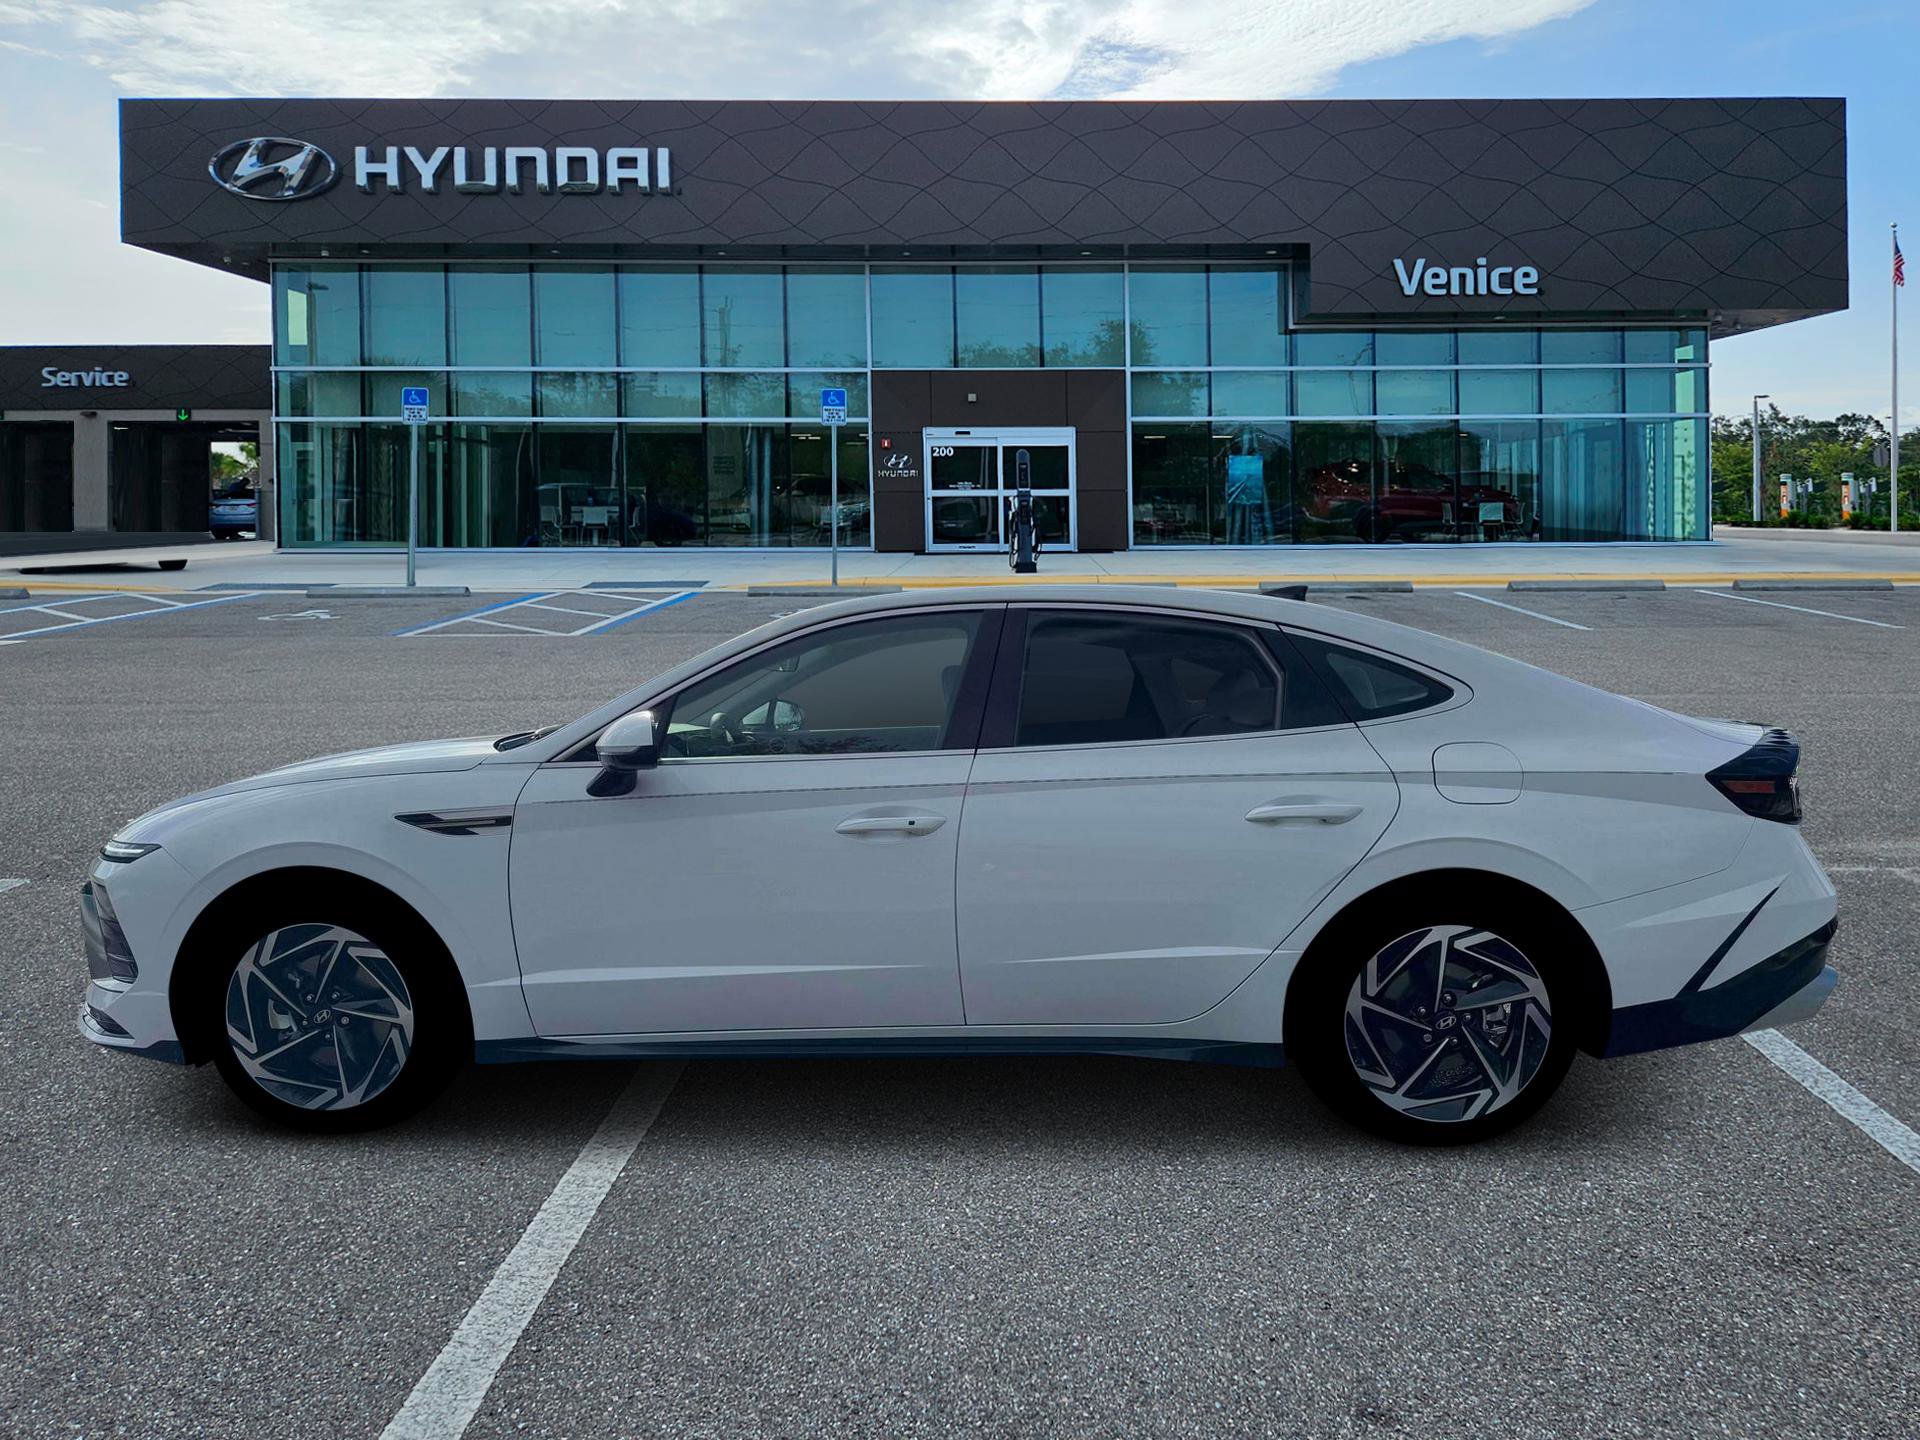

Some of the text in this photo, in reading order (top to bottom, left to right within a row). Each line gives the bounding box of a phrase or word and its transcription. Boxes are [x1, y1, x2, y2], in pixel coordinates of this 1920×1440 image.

[354, 146, 672, 195] HYUNDAI
[1392, 256, 1540, 296] Venice
[40, 366, 130, 388] Service
[932, 446, 954, 457] 200
[877, 469, 919, 478] HYUNDAI
